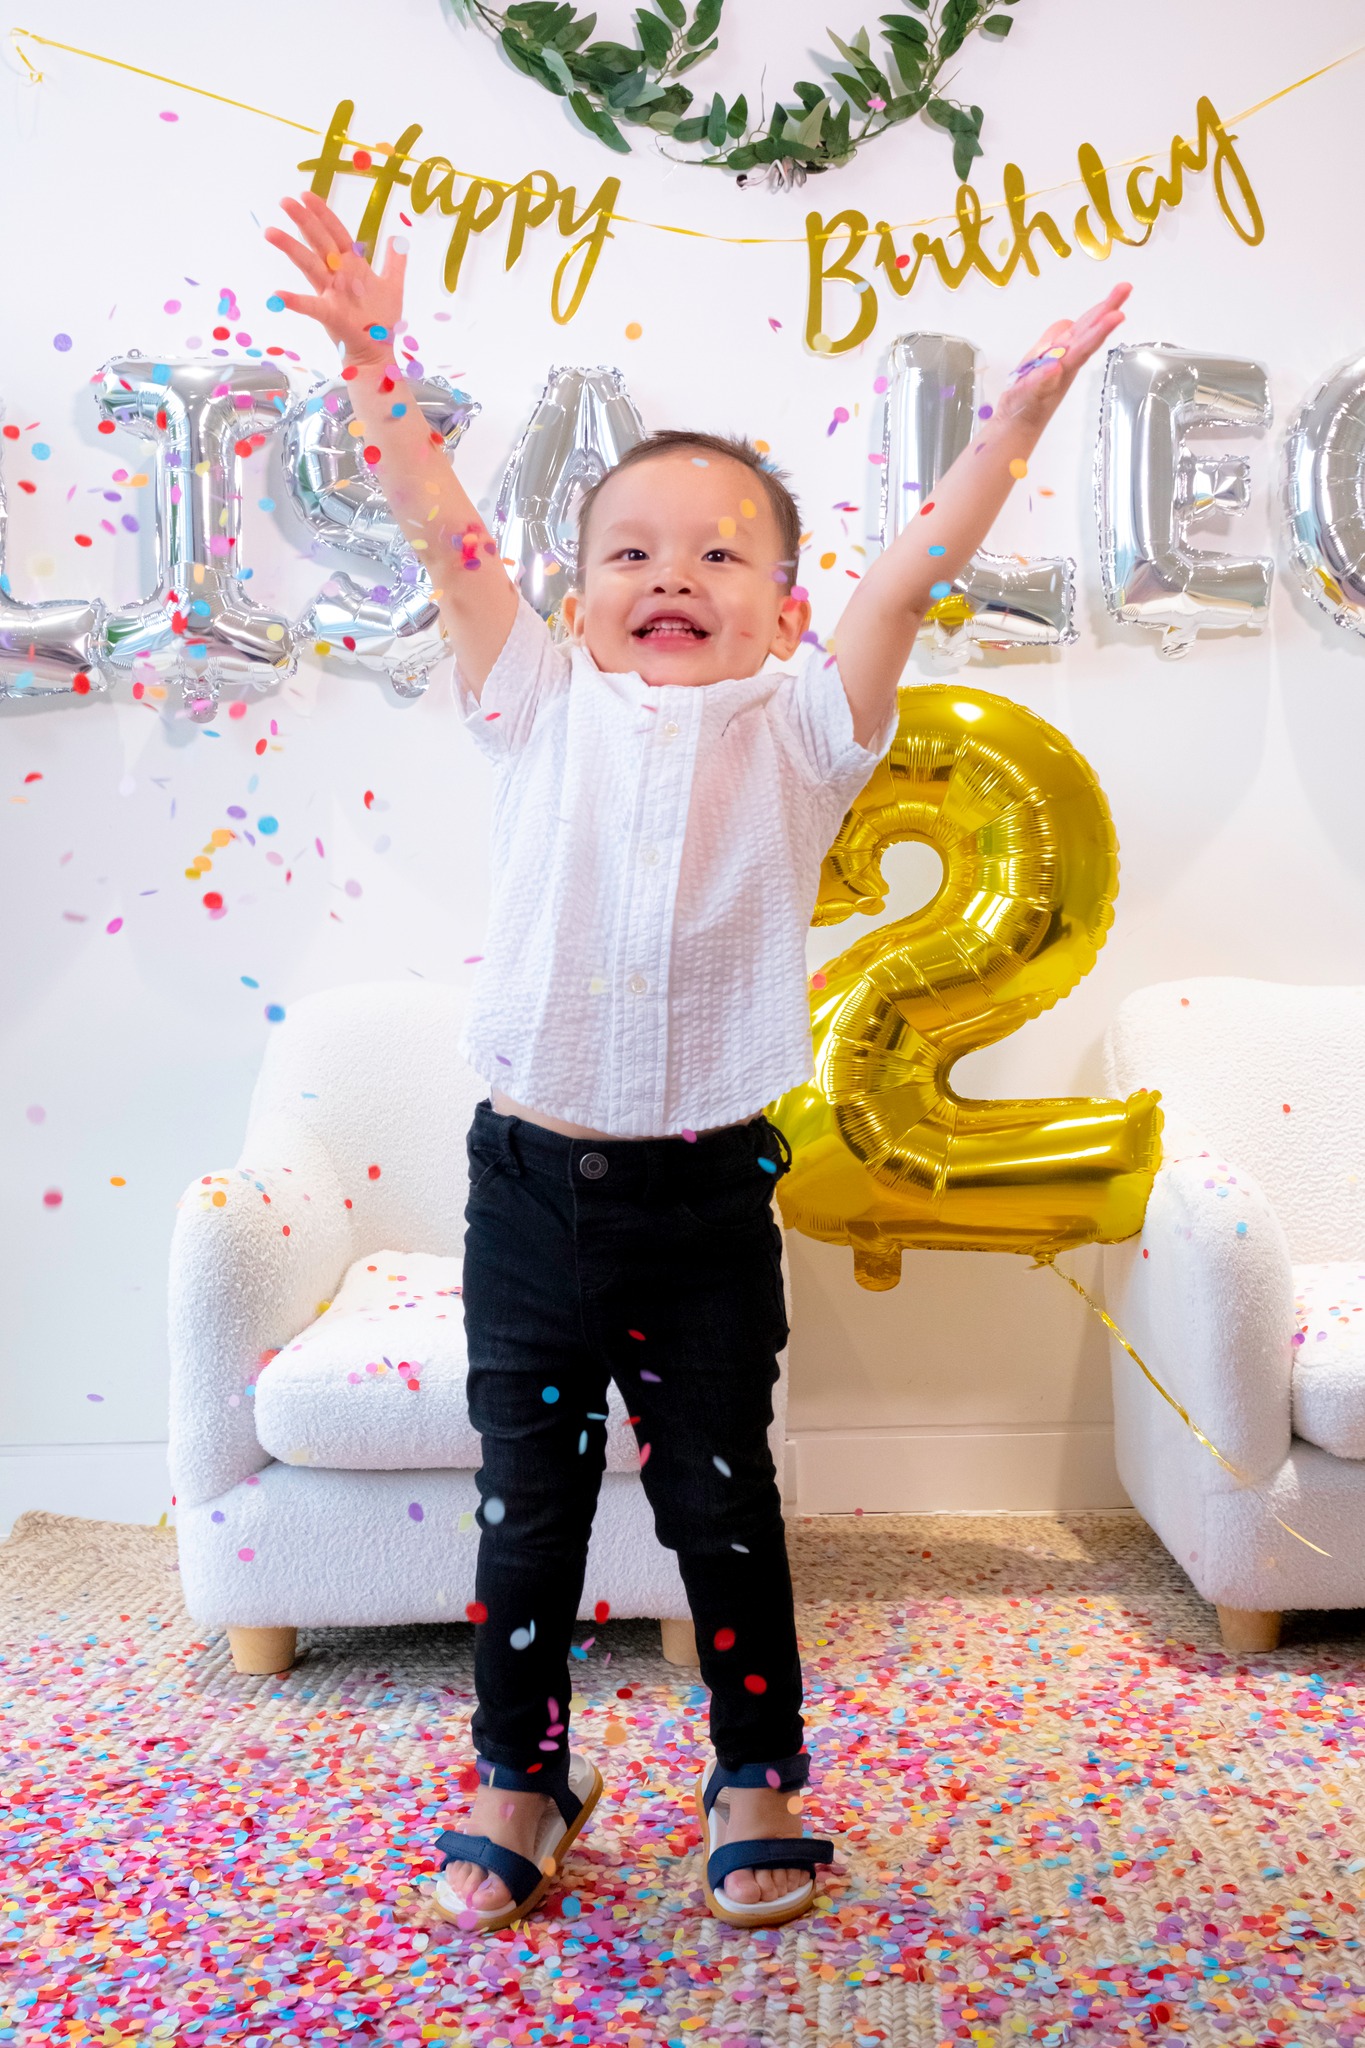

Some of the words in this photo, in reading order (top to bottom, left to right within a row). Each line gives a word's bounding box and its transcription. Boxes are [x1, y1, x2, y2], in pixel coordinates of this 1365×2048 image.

[297, 99, 621, 325] Happy
[803, 96, 1264, 356] Birthday
[765, 684, 1163, 1257] 2
